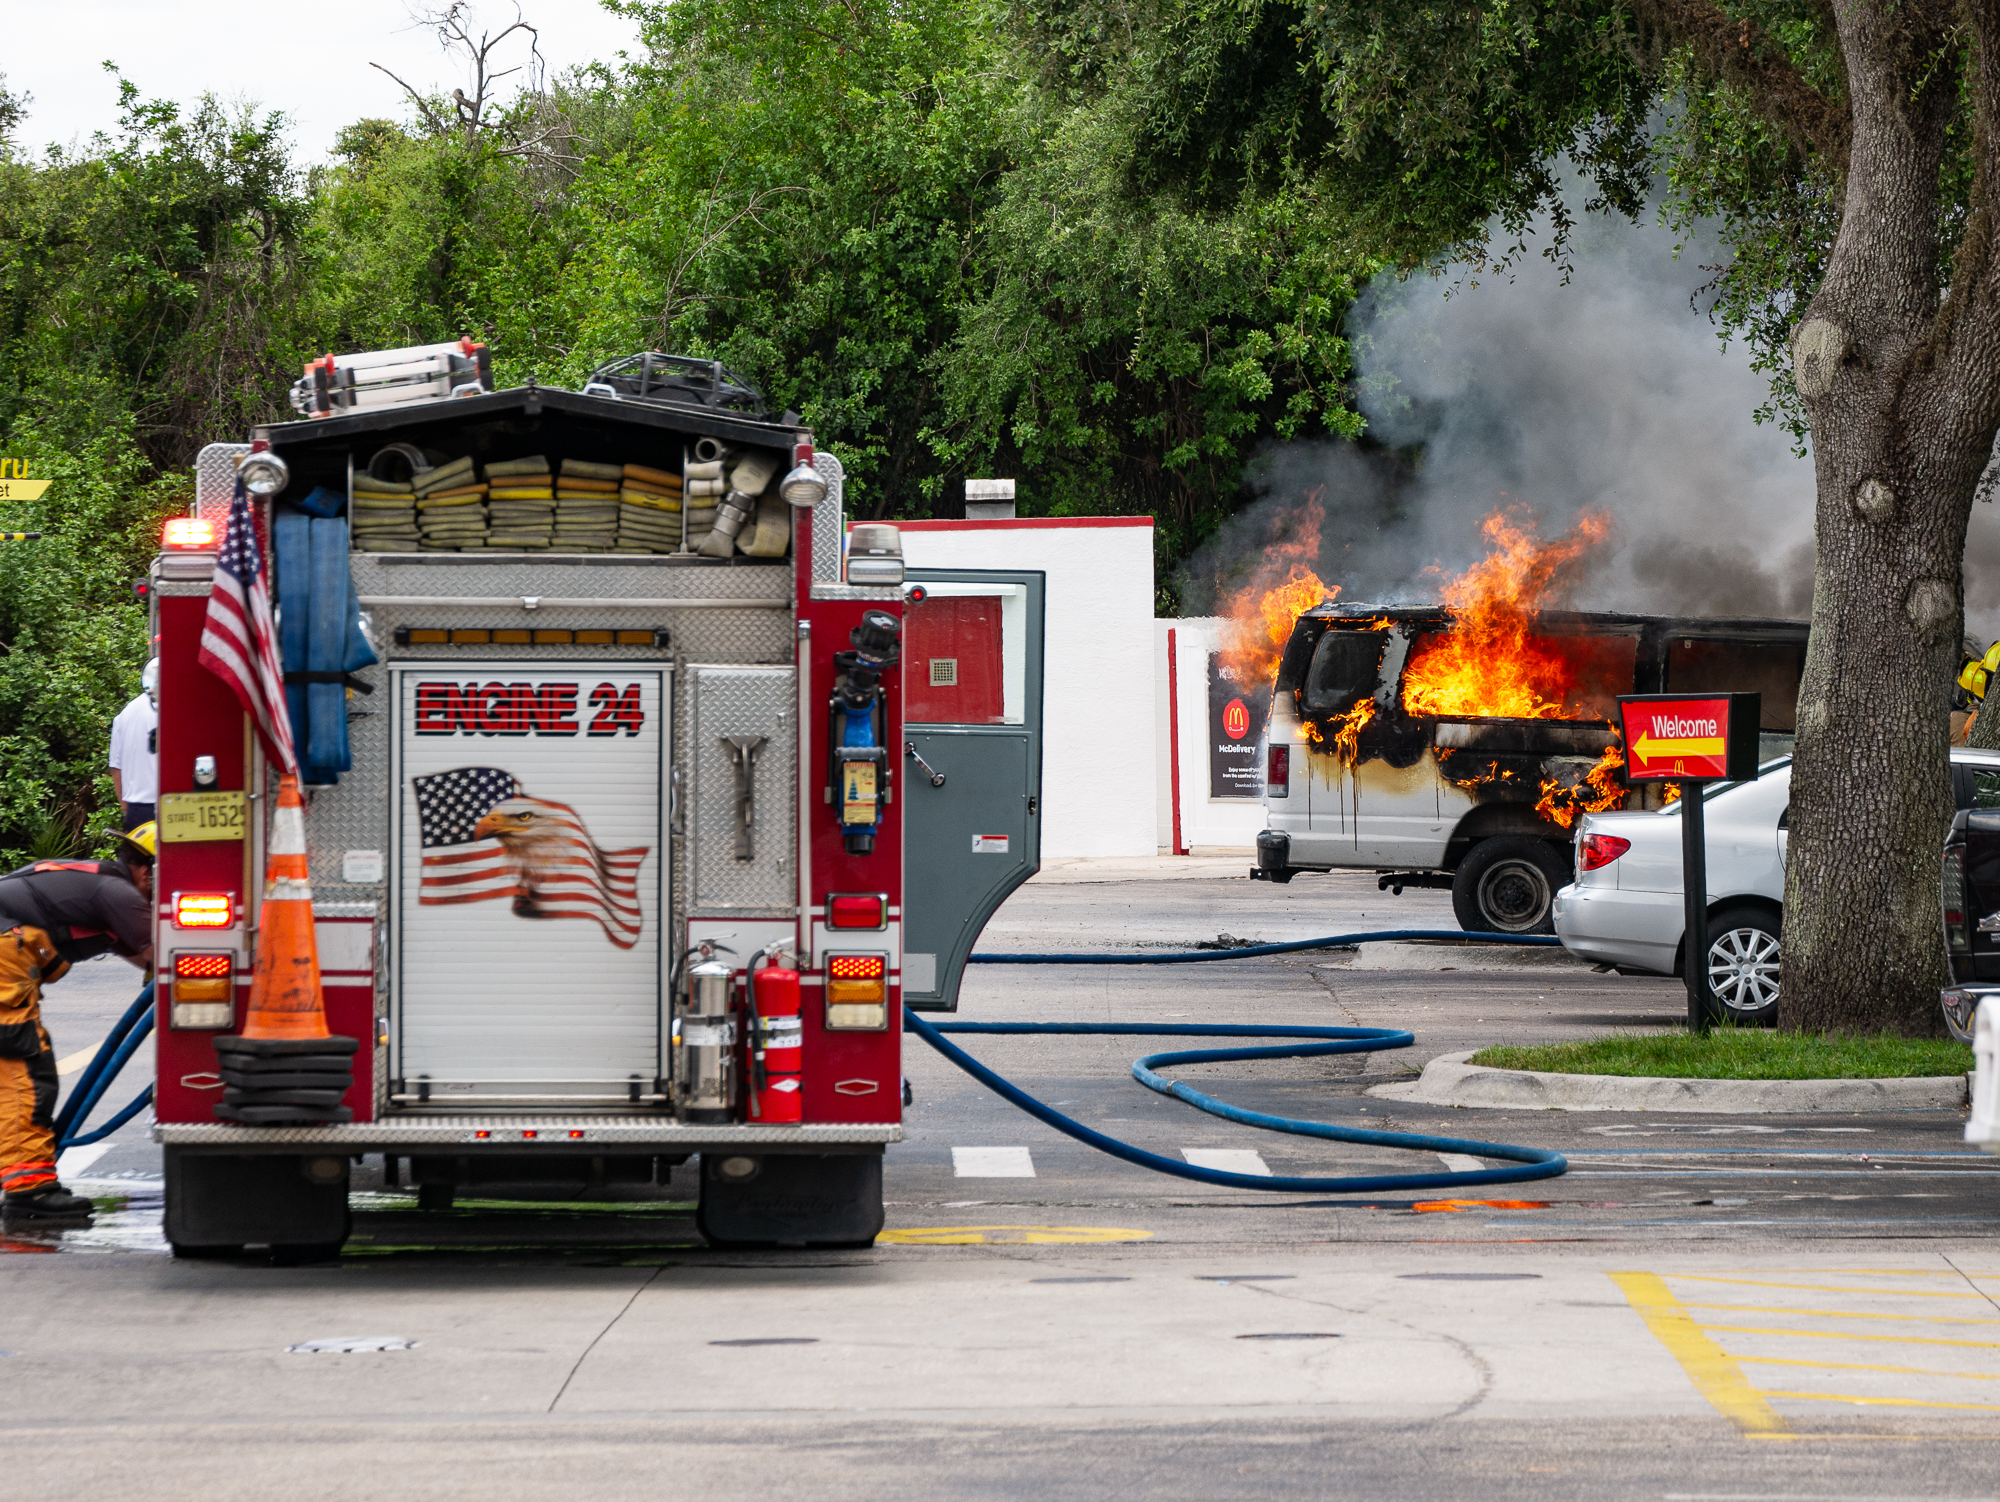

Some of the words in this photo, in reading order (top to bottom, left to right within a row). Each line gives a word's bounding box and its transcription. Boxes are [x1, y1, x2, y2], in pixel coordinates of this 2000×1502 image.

[414, 682, 579, 737] ENGINE
[586, 682, 644, 737] 24
[1652, 715, 1717, 738] Welcome
[1218, 744, 1256, 755] McDelivery
[167, 812, 195, 824] STATE
